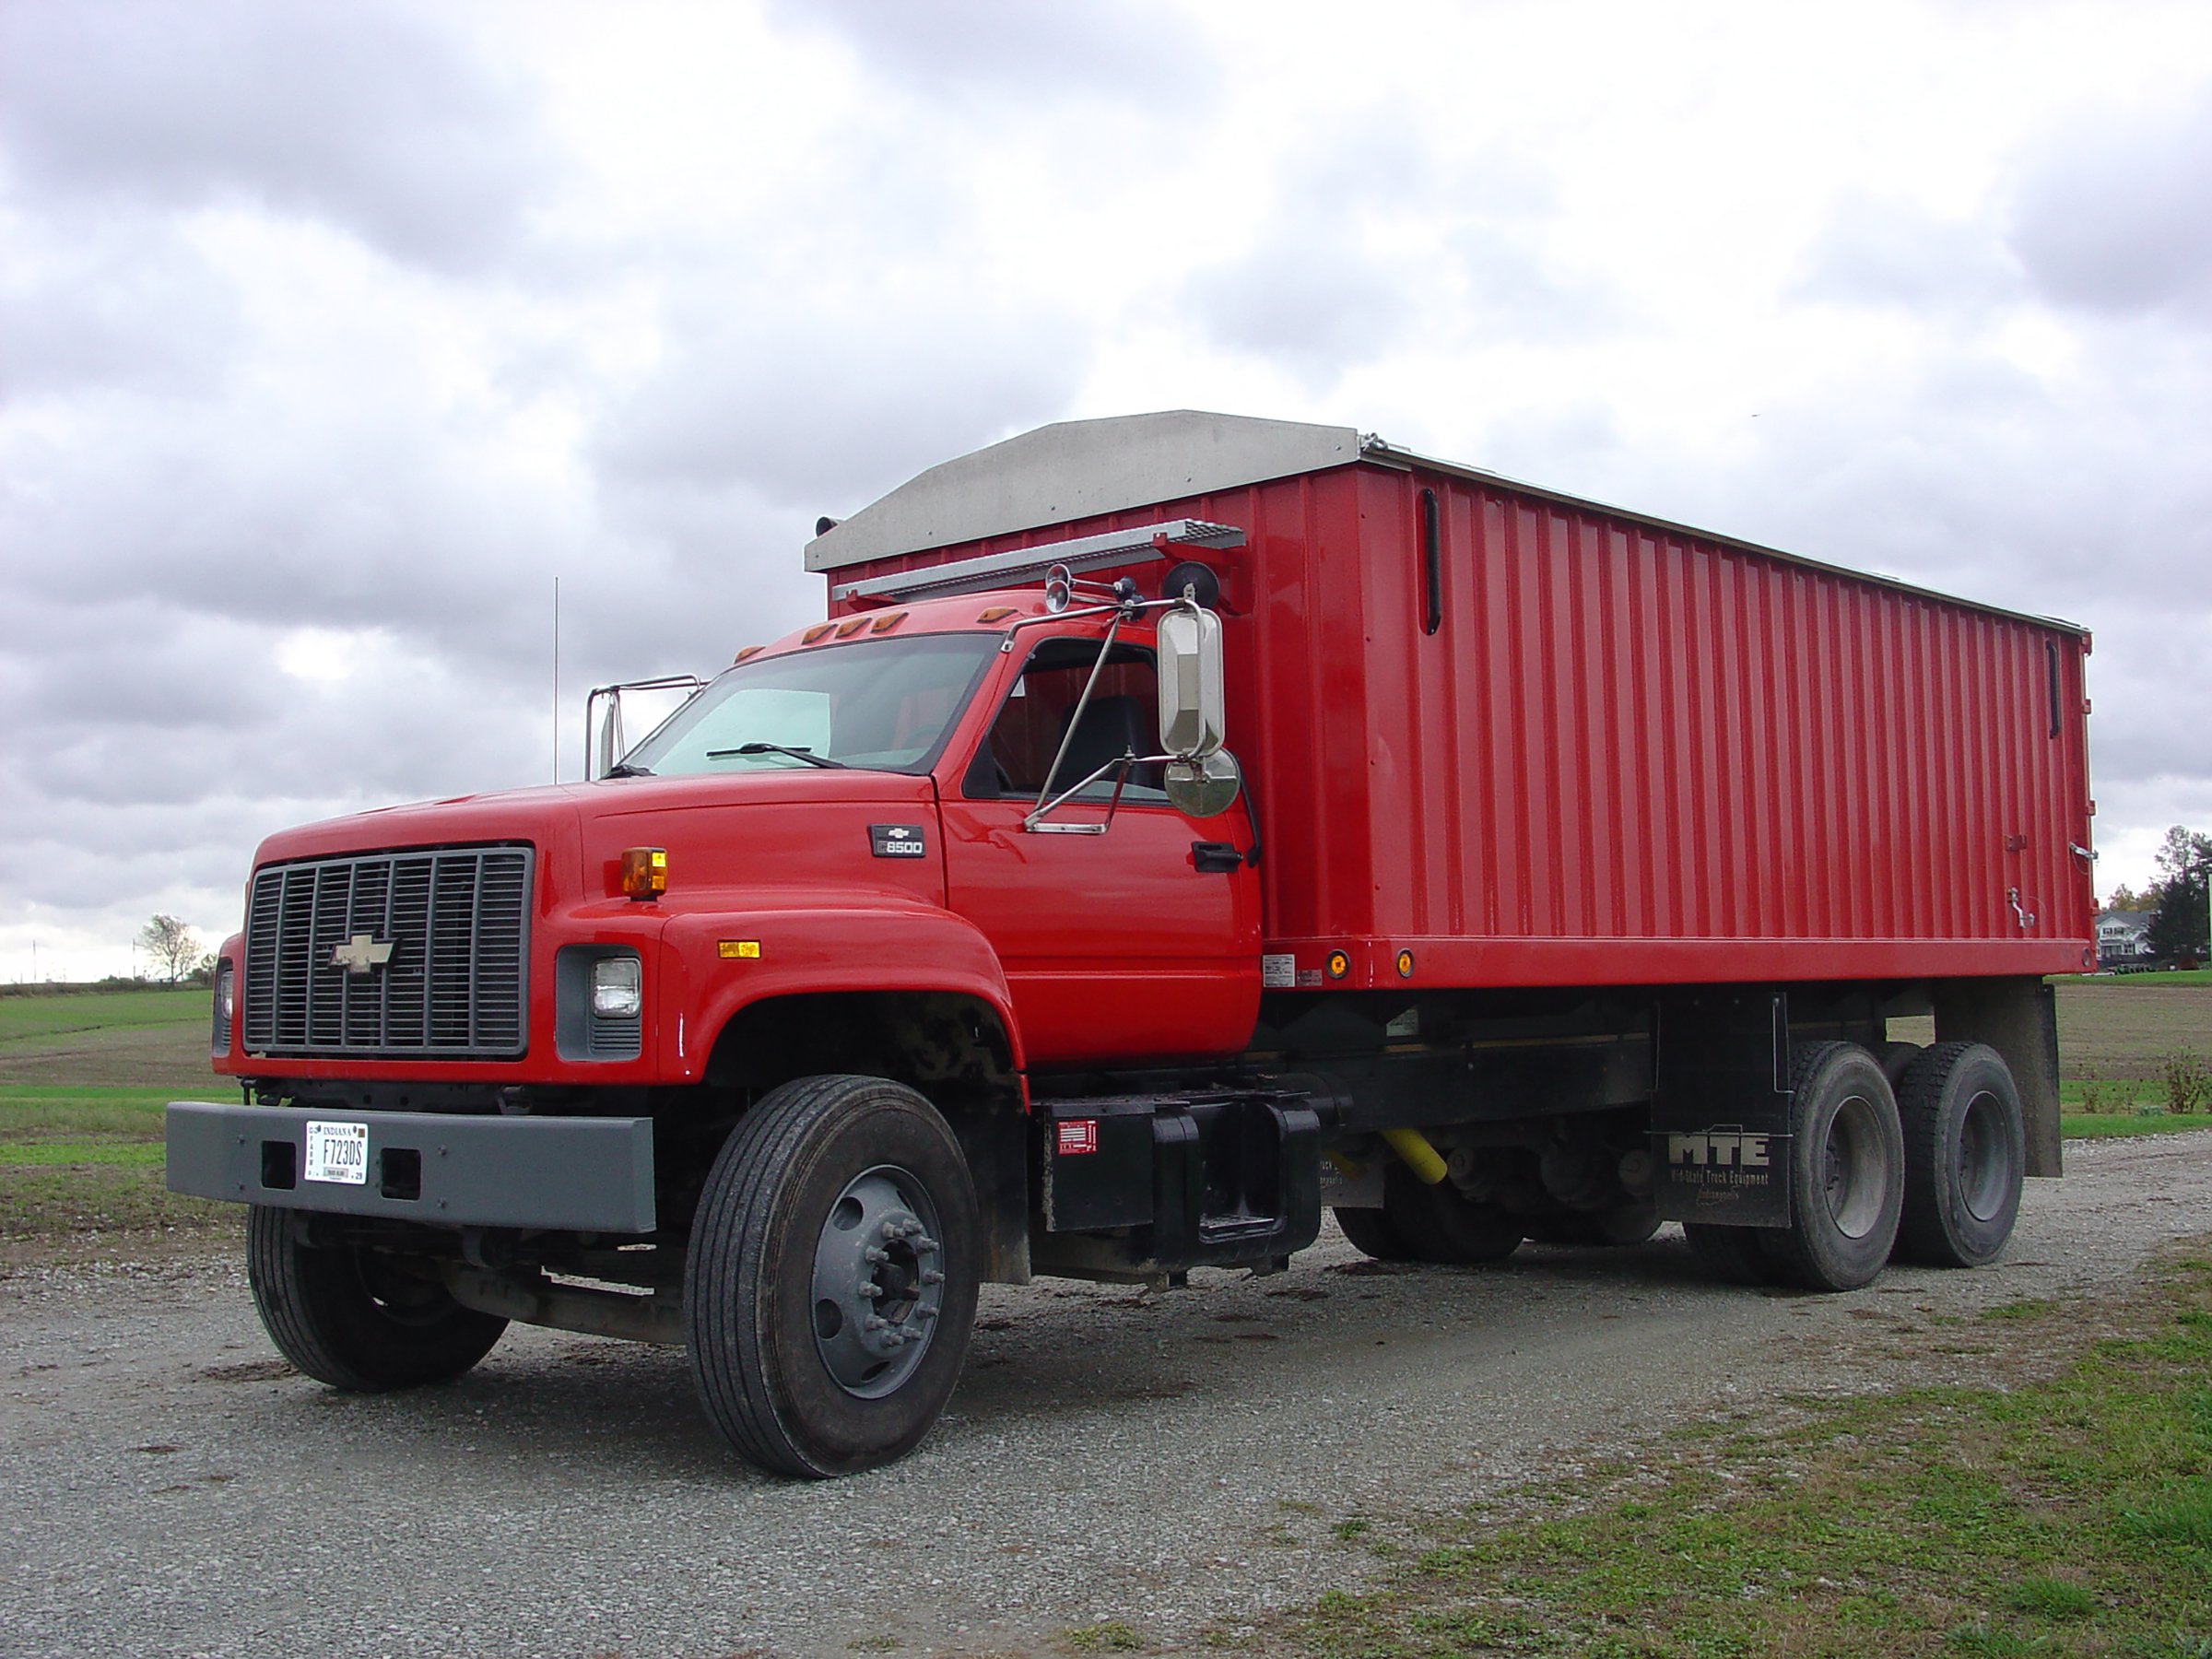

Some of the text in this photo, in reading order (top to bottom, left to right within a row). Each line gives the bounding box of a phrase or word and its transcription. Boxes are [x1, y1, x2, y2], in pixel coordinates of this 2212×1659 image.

[324, 1126, 351, 1136] INDIANA
[324, 1139, 362, 1166] F723DS
[1669, 1135, 1770, 1166] MTE
[1707, 1170, 1727, 1184] Truck
[1730, 1171, 1769, 1188] Equipment
